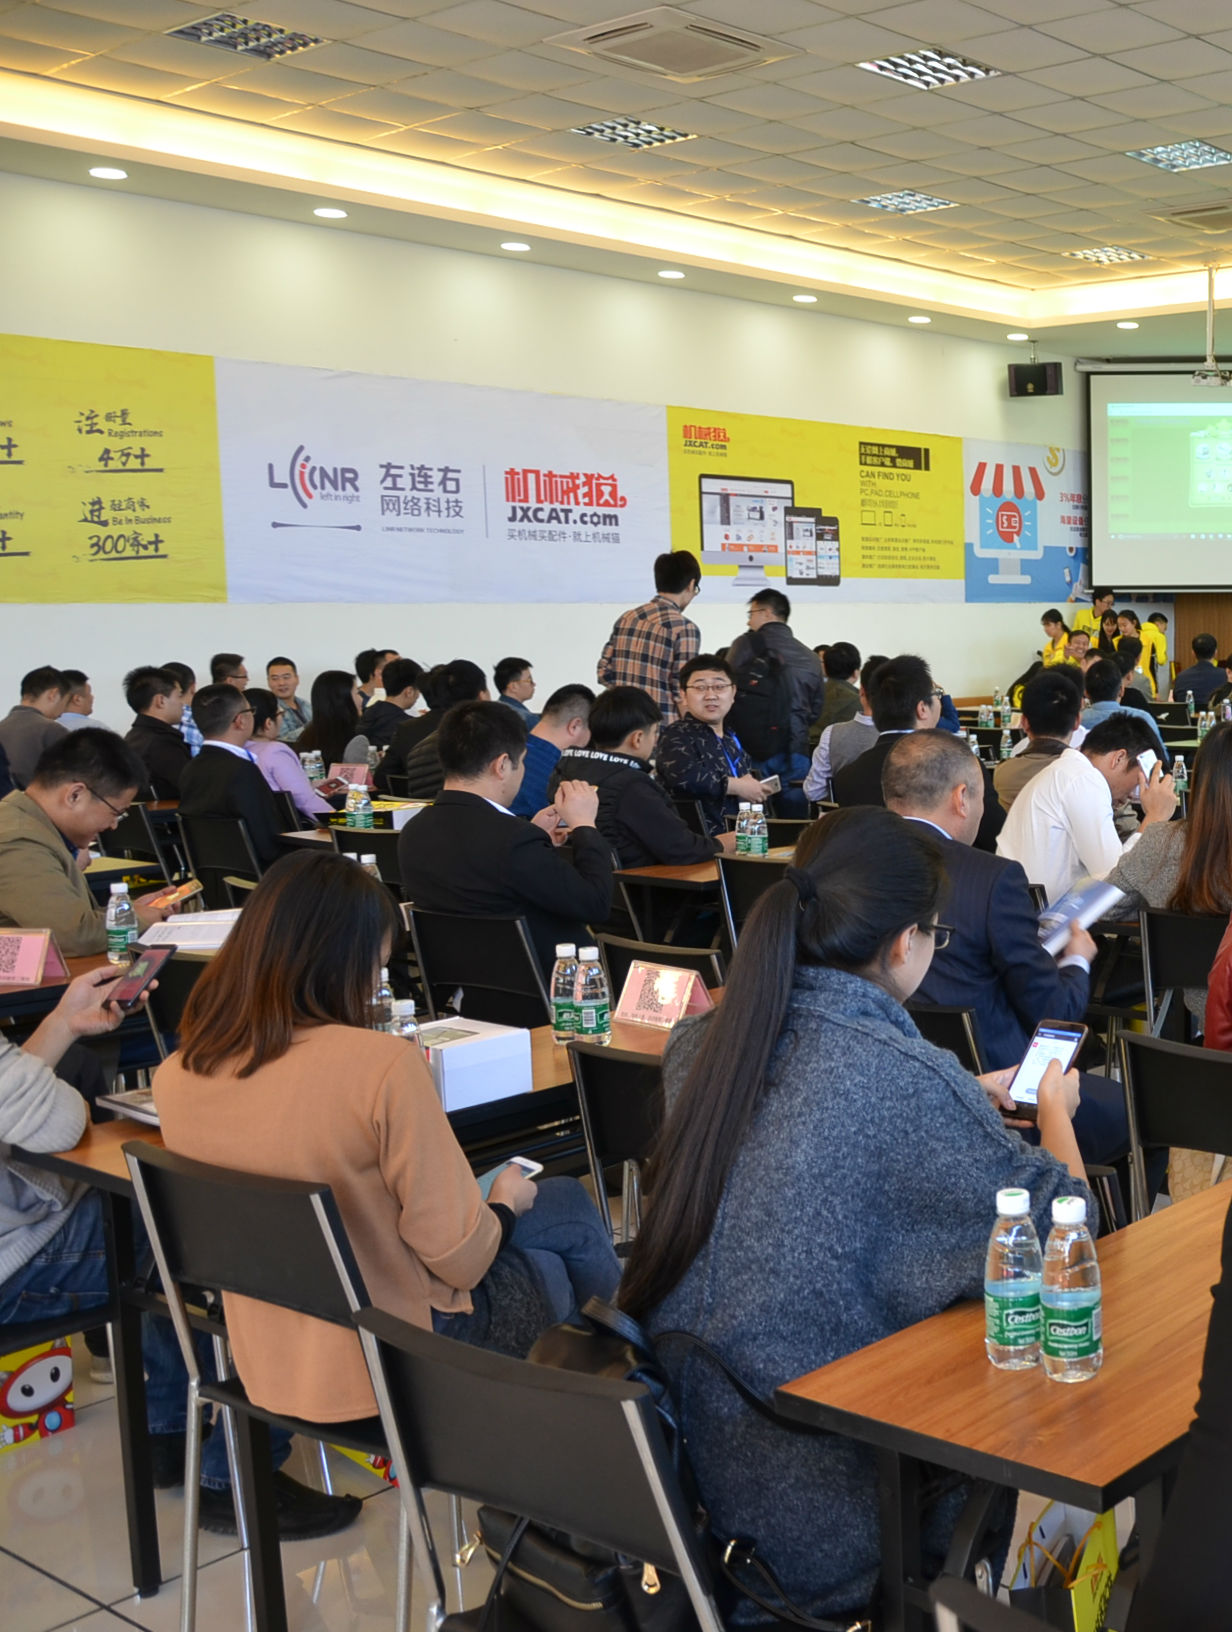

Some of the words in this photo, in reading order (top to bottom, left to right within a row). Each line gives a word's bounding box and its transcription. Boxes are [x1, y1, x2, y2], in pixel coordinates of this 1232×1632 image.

[107, 428, 164, 439] Registrations
[379, 462, 462, 494] 左连右
[860, 470, 876, 479] CAN
[877, 471, 894, 480] FIND
[896, 472, 911, 482] YOU
[504, 467, 628, 508] 机械猫
[380, 494, 464, 518] 网络科技
[112, 516, 124, 526] Be
[135, 516, 172, 526] Business
[507, 505, 619, 527] JXCAT.com
[574, 749, 589, 757] LOVE
[590, 751, 608, 761] LOVE
[609, 755, 629, 764] LOVE
